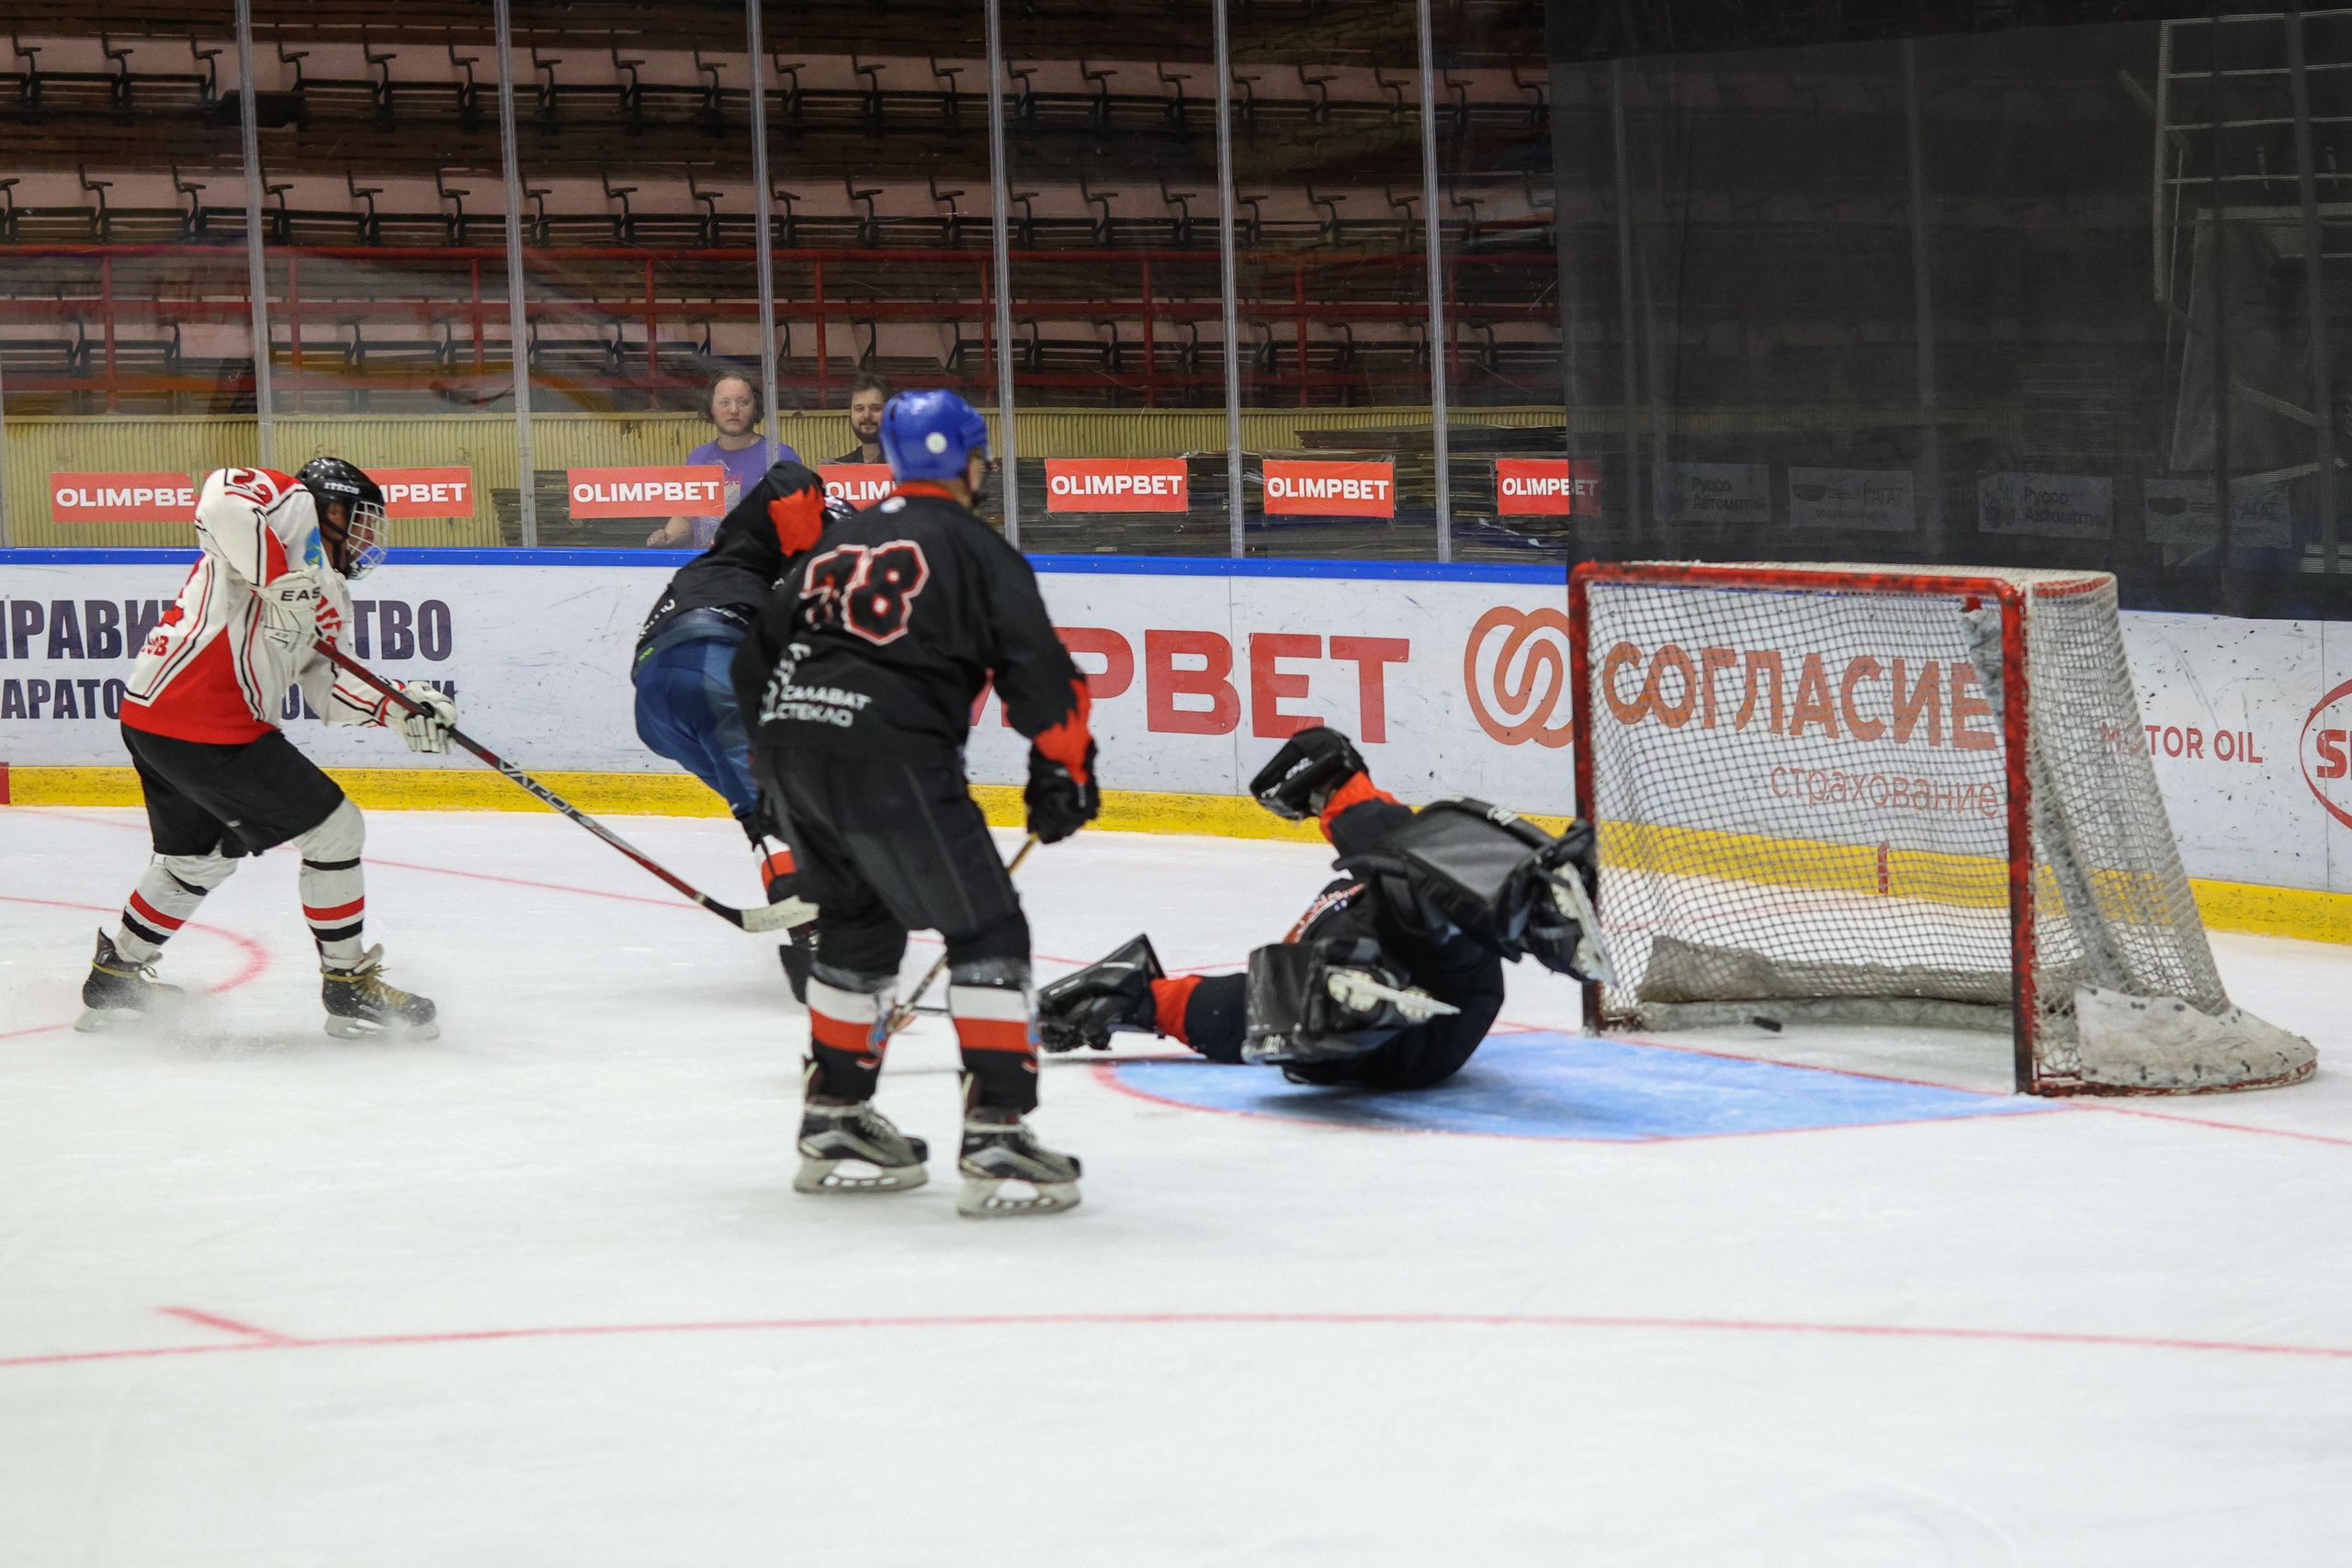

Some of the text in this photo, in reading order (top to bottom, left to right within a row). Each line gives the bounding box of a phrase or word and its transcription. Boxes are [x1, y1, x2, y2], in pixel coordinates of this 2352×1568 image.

[56, 487, 196, 507] OLIMPBE
[572, 480, 720, 503] OLIMPBET
[825, 479, 898, 502] OLIM
[1050, 474, 1183, 496] OLIMPBET
[1267, 477, 1390, 501] OLIMPBET
[280, 587, 321, 602] EAS
[1, 678, 124, 720] АРАТО
[1602, 641, 1997, 750] СОГЛАСИЕ
[2213, 729, 2264, 763] OIL
[2316, 728, 2352, 780] S
[1770, 766, 1999, 818] страхование
